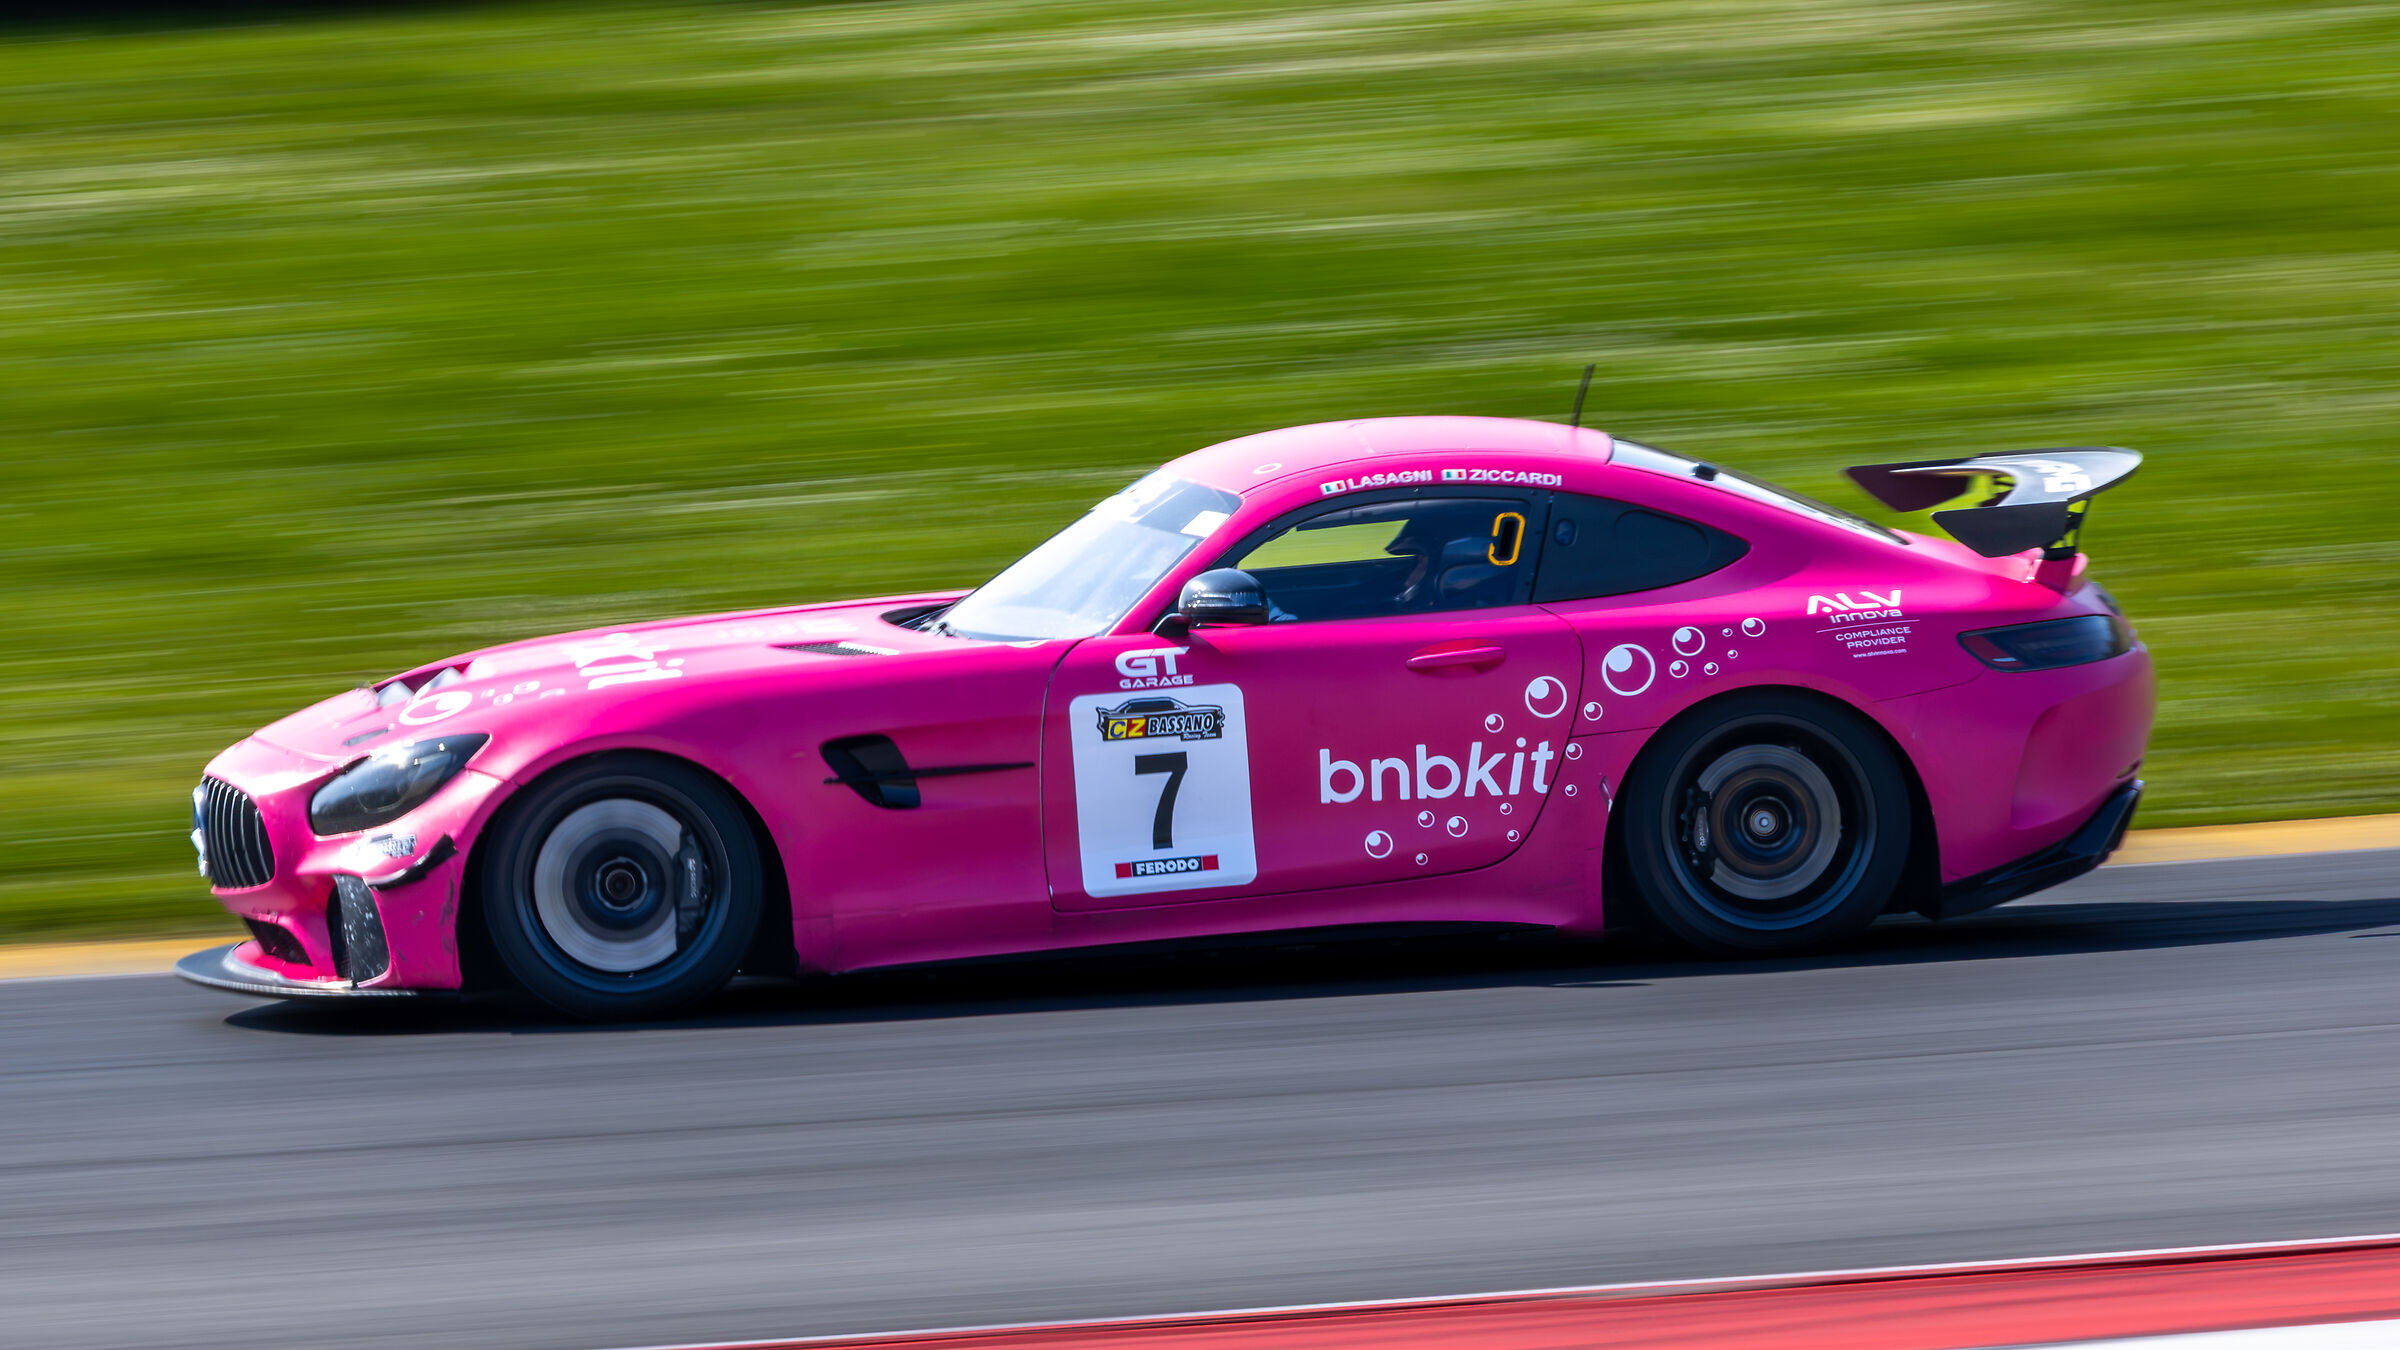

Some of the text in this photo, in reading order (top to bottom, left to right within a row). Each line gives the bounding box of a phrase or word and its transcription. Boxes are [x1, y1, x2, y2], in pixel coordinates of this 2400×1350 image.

[1347, 468, 1562, 490] LASAGNI ZICCARDI
[1807, 589, 1902, 615] ALV
[1835, 627, 1911, 641] COMPLIANCE
[1846, 636, 1906, 649] PROVIDER
[1115, 646, 1190, 678] GT
[1119, 674, 1194, 689] GARAGE
[1147, 714, 1215, 736] BASSANO
[1319, 737, 1554, 804] bnbkit
[1135, 751, 1188, 850] 7
[1135, 857, 1200, 876] FERODO
